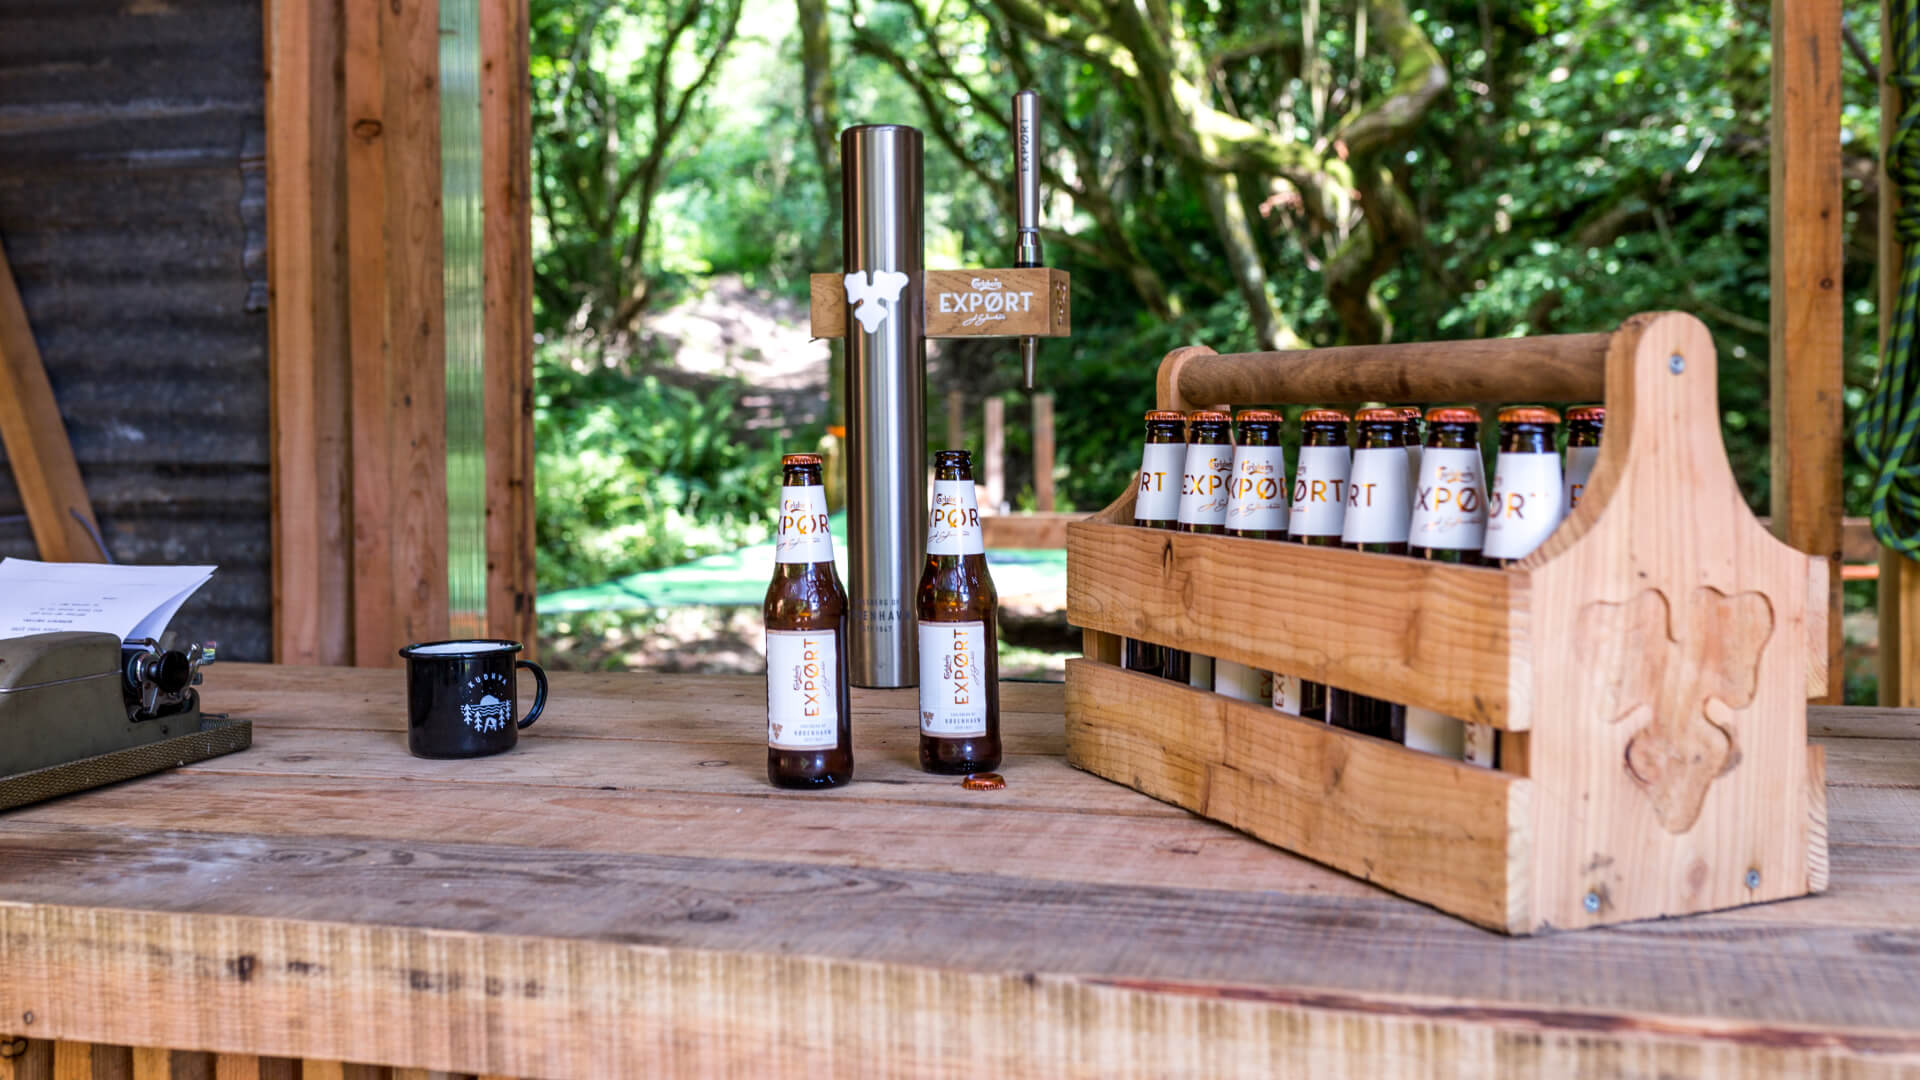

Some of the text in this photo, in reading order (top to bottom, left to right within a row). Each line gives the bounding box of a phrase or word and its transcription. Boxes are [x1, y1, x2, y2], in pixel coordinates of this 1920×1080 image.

[939, 291, 1034, 313] EXPØRT
[1141, 472, 1168, 492] RT
[1295, 479, 1344, 502] ØRT
[1348, 483, 1377, 507] RT
[803, 638, 819, 717] EXPØRT
[953, 628, 969, 705] EXPØRT
